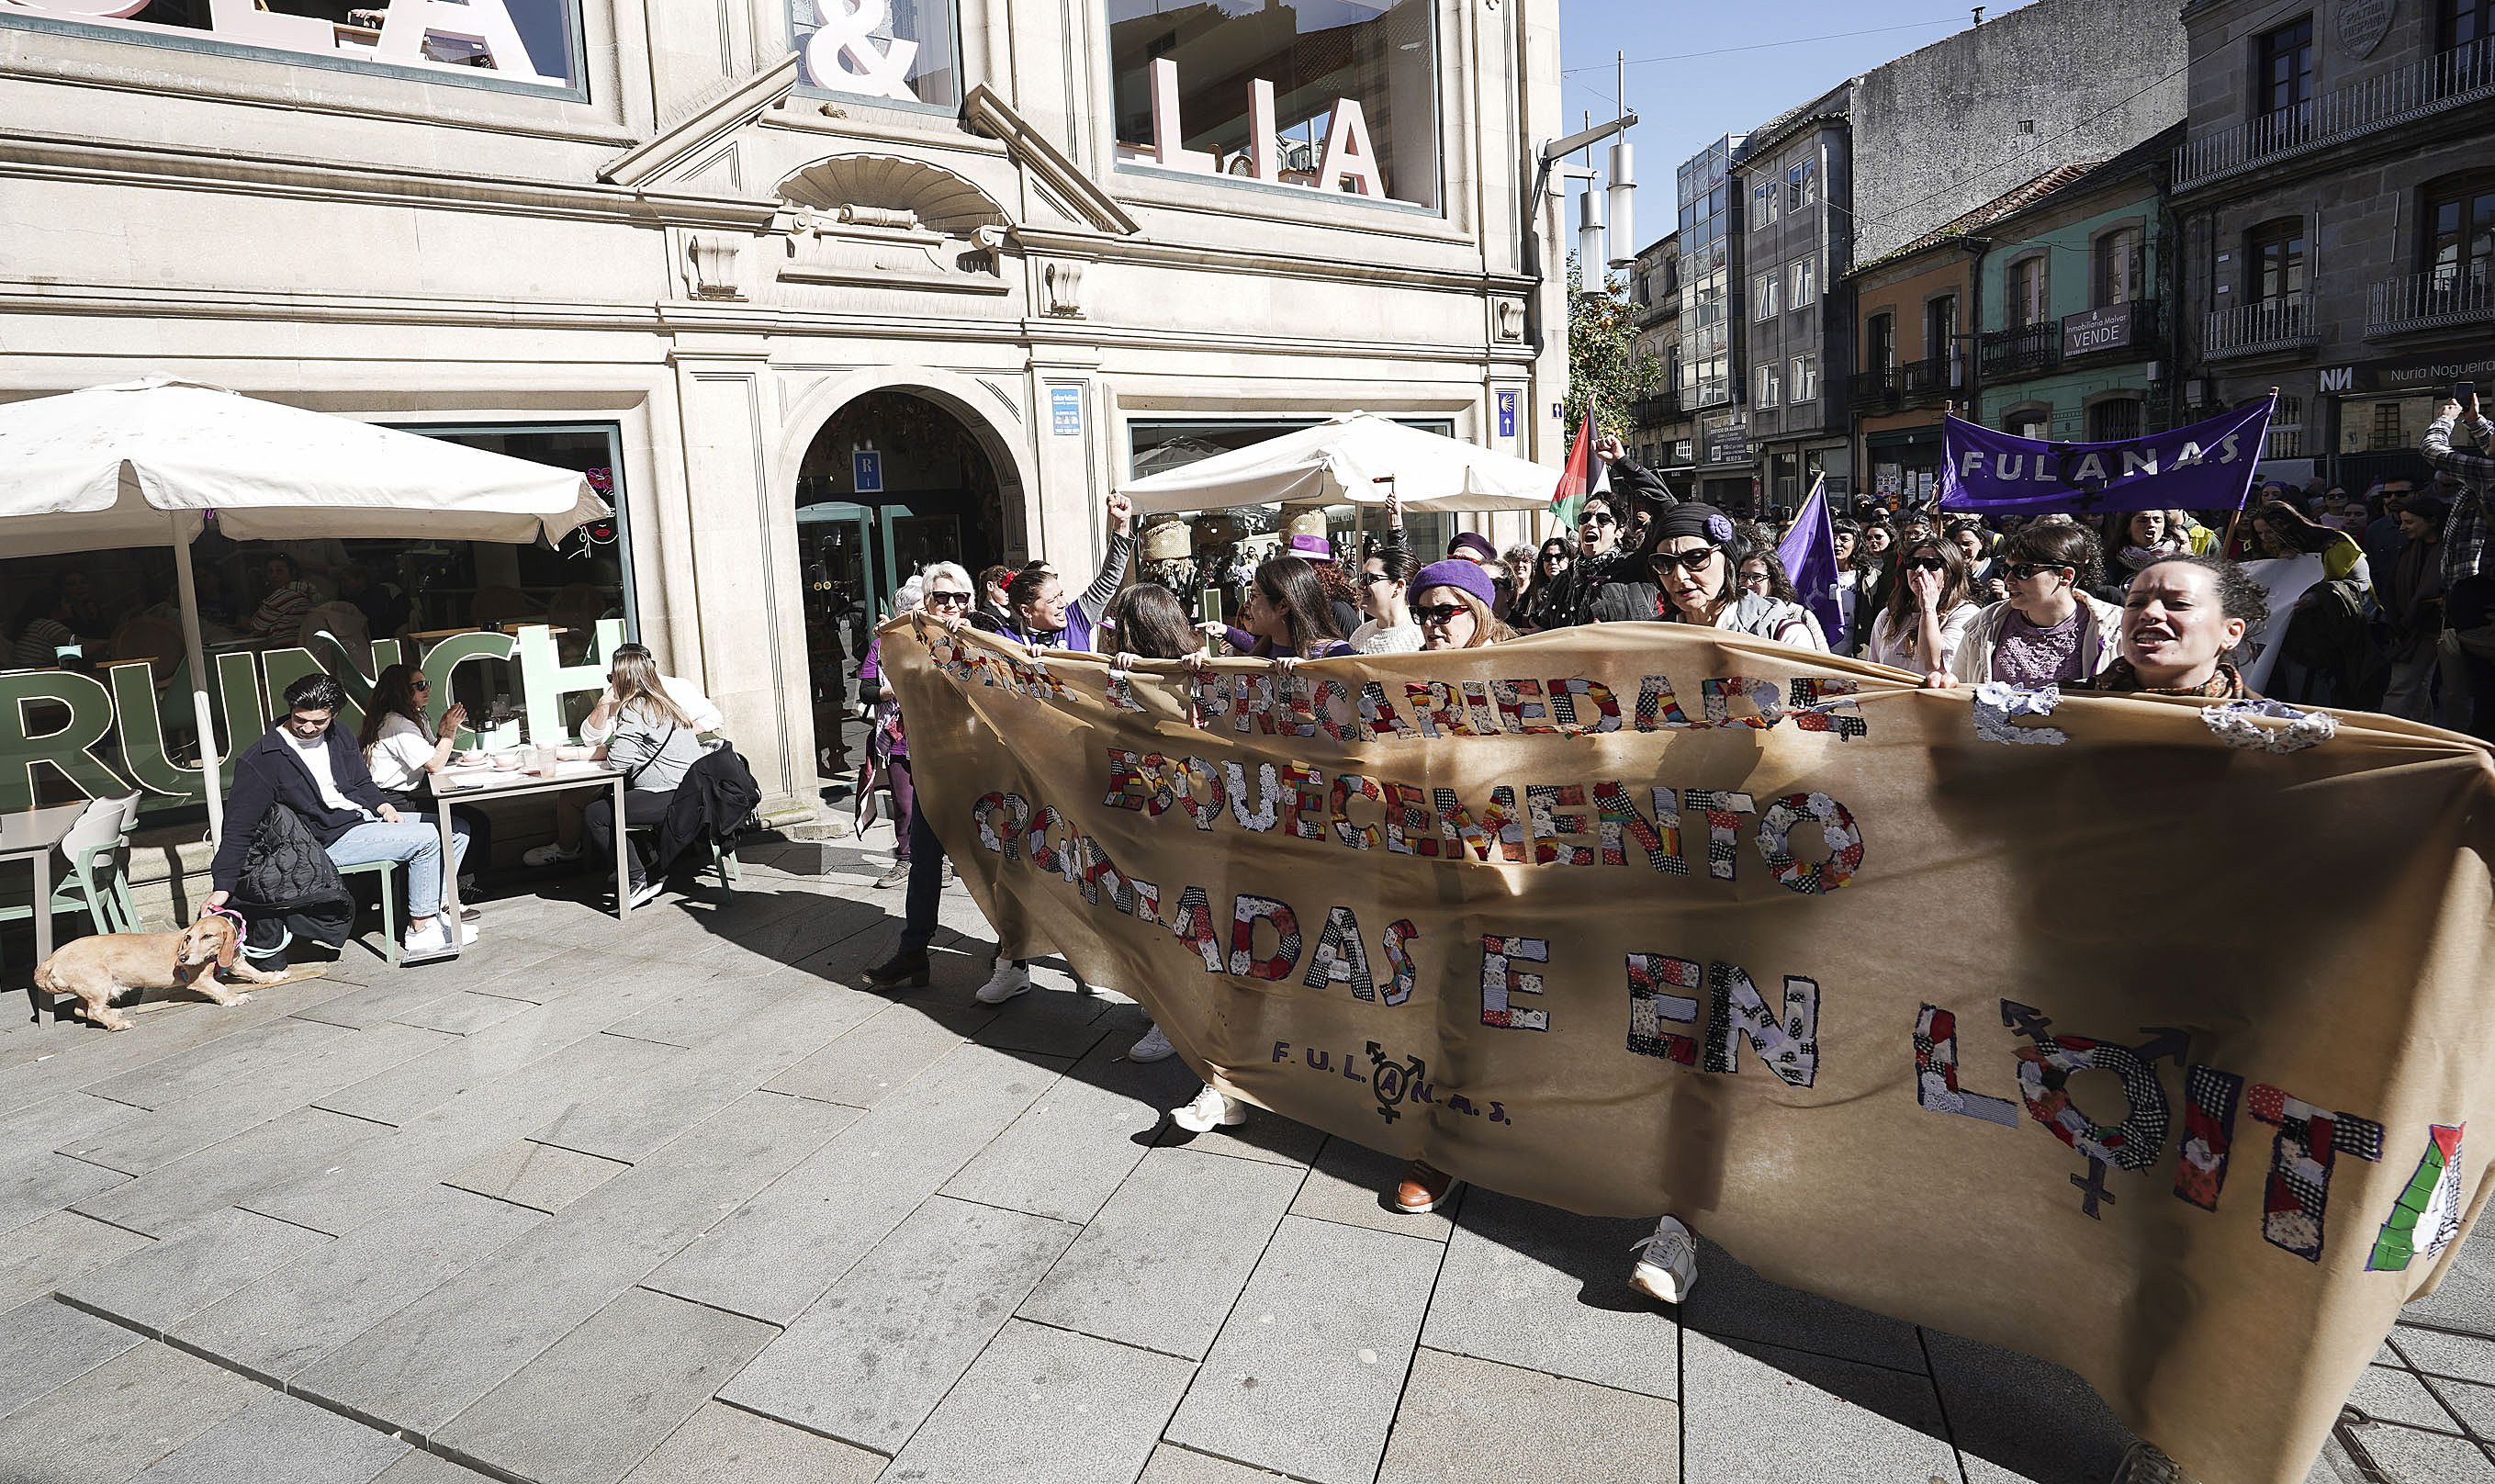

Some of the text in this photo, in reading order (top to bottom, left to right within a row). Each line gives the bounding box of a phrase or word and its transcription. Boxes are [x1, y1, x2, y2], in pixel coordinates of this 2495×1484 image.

[1149, 57, 1387, 199] LIA
[2066, 314, 2128, 333] Inmobiliaria Malvar
[2074, 324, 2120, 348] VENDE
[2391, 358, 2495, 382] Nuria Nogueira
[861, 457, 872, 473] R
[1190, 670, 1869, 745] PRECARIEDADE
[1103, 747, 1866, 895] ESQUECEMENTO
[1479, 932, 1550, 1032] E
[1624, 951, 1821, 1088] EN
[1912, 998, 2468, 1272] LOITA
